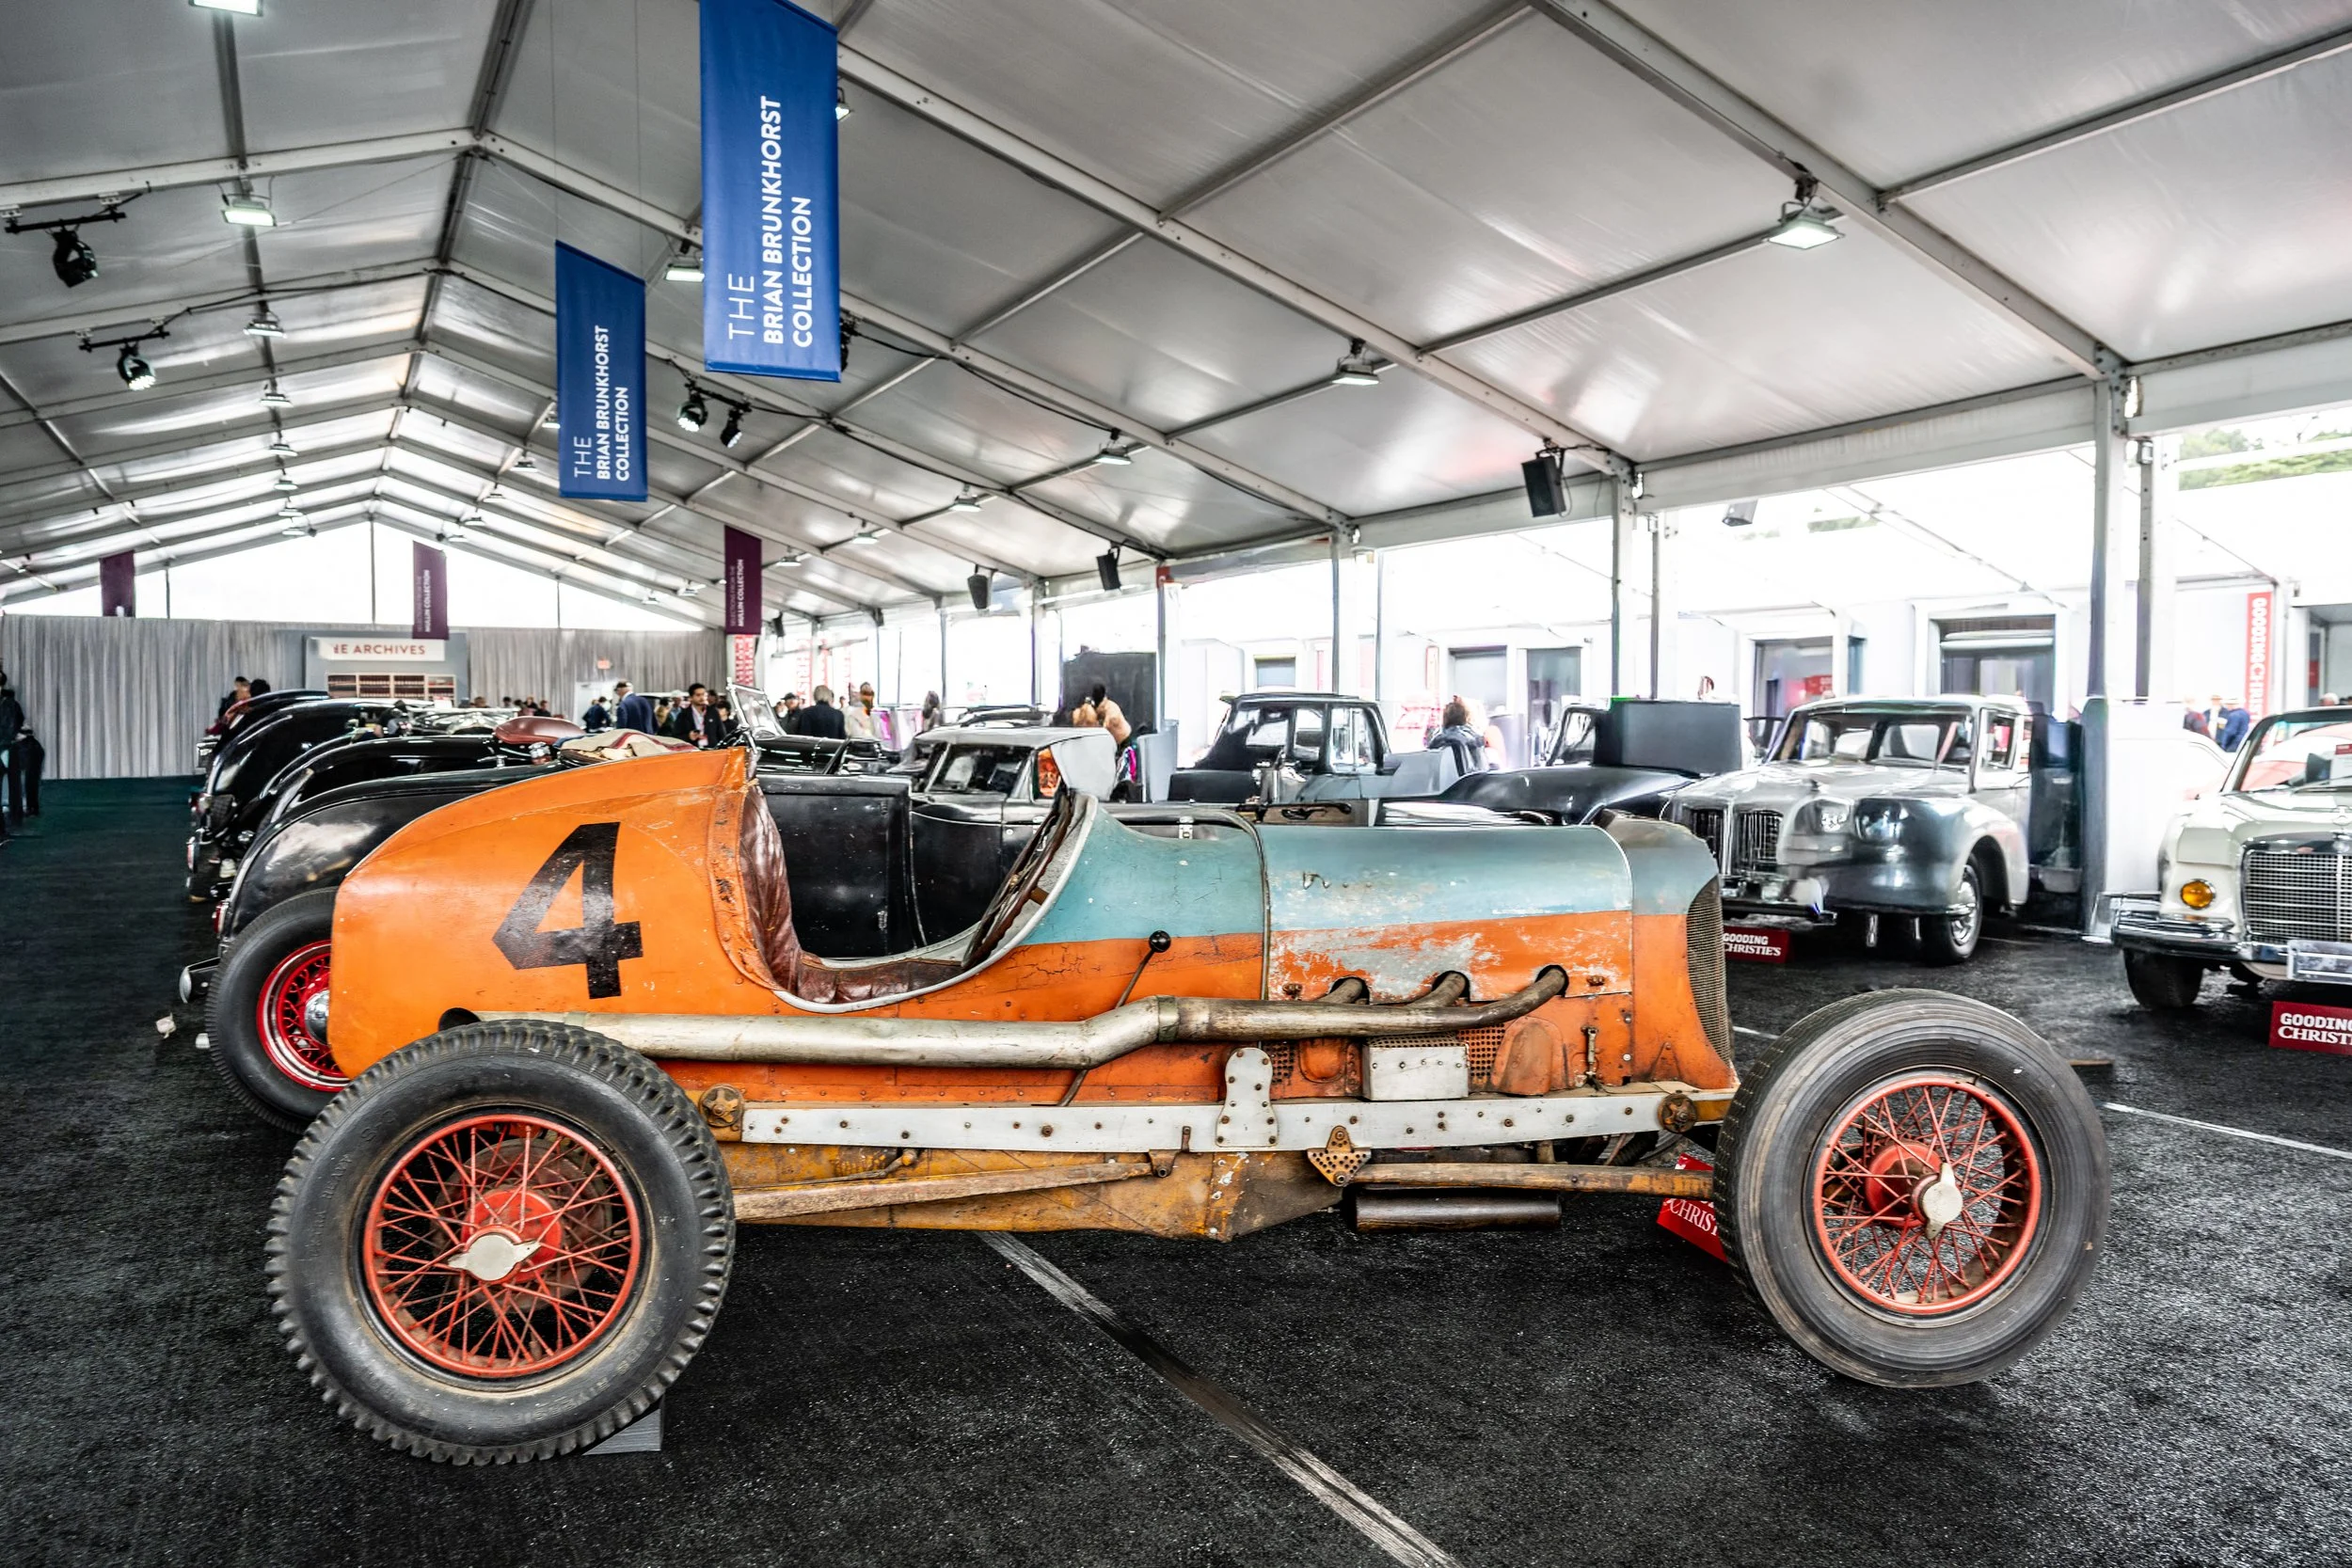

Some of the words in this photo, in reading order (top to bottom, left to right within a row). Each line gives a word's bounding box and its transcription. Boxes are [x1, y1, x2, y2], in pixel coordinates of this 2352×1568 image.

[760, 95, 783, 264] BRUNKHORST
[791, 197, 813, 348] COLLECTION
[728, 274, 755, 340] THE
[763, 270, 784, 344] BRIAN
[595, 325, 610, 430] BRUNKHORST
[574, 436, 592, 478] THE
[596, 433, 611, 480] BRIAN
[615, 387, 629, 482] COLLECTION
[354, 644, 426, 655] ARCHIVES
[2250, 597, 2267, 663] GOODING
[492, 821, 644, 1000] 4
[1722, 932, 1769, 945] GOODING
[2278, 1025, 2352, 1045] CHRIST
